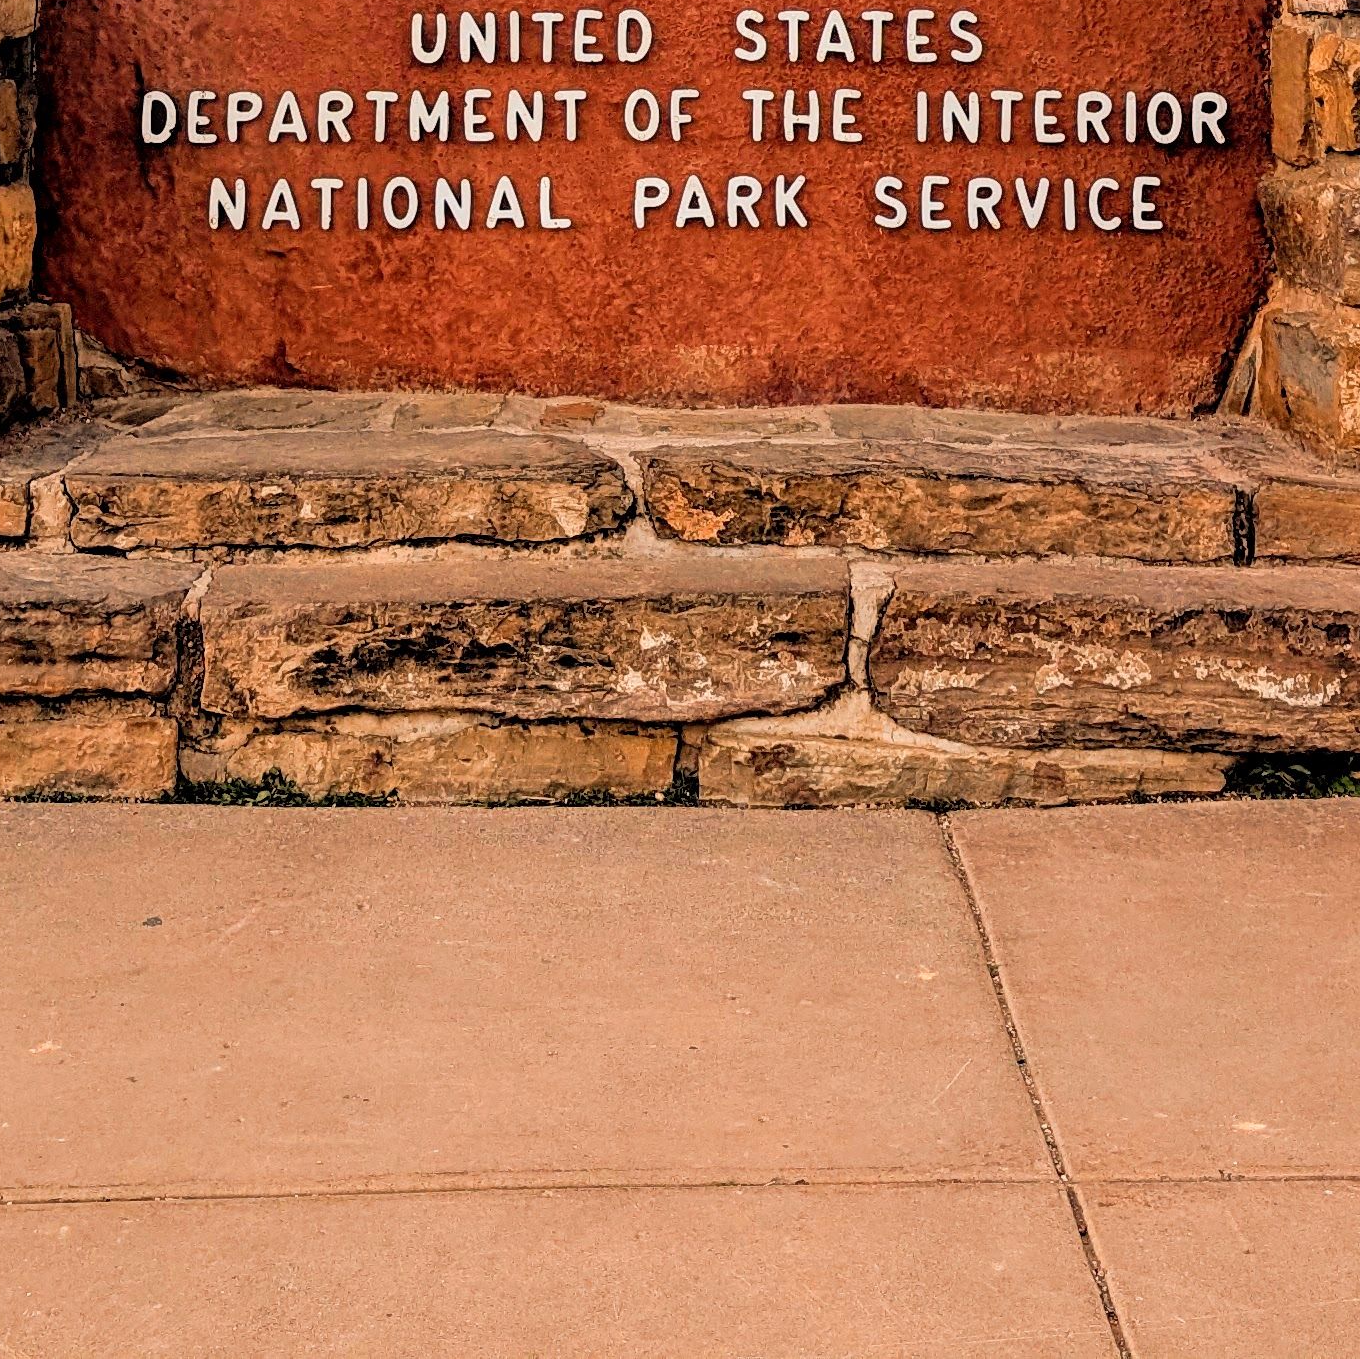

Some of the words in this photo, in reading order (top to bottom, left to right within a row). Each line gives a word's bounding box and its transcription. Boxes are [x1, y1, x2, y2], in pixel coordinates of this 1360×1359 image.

[411, 9, 653, 64] UNITED
[734, 9, 984, 64] STATES
[141, 88, 587, 144] DEPARTMENT
[624, 88, 700, 142] OF
[742, 88, 863, 143] THE
[916, 89, 1228, 145] INTERIOR
[208, 175, 572, 231] NATIONAL
[634, 174, 808, 229] PARK
[874, 175, 1164, 231] SERVICE
